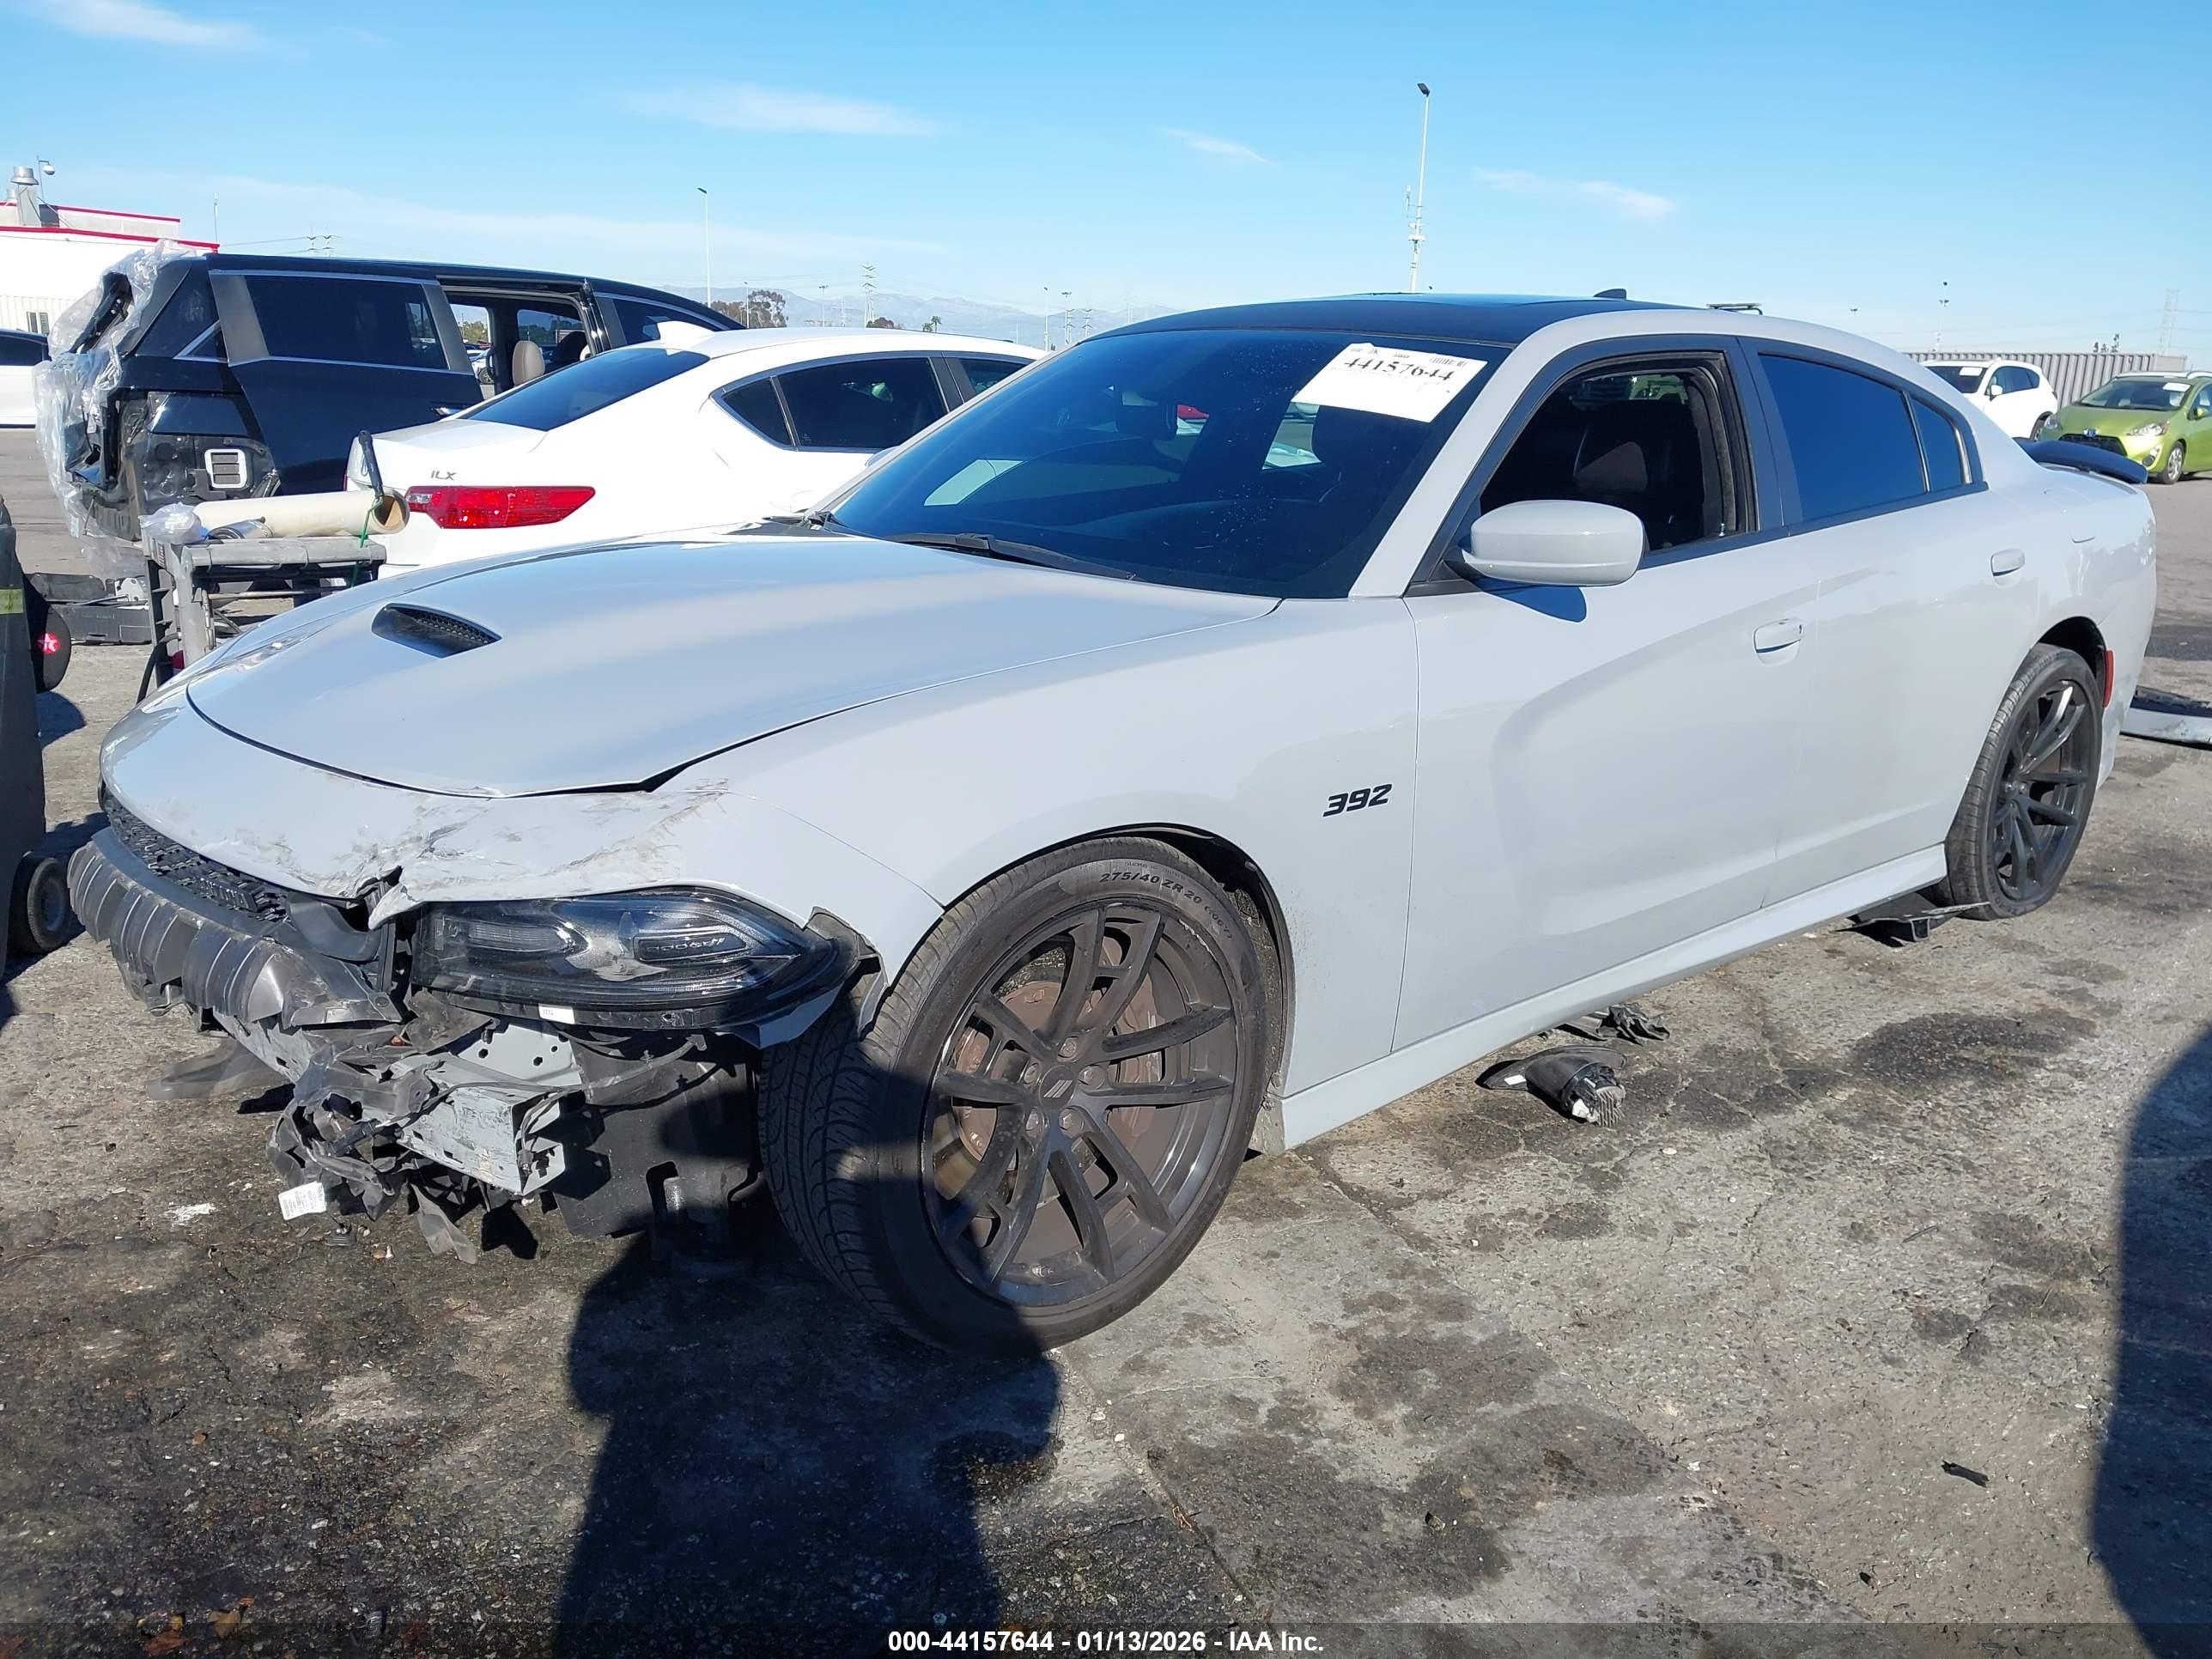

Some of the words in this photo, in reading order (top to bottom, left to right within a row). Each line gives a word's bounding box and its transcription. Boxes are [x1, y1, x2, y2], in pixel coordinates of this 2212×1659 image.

[1344, 358, 1455, 380] 44157644
[431, 471, 456, 480] ILX
[1323, 783, 1393, 817] 392
[1100, 872, 1159, 884] 275/40
[1162, 879, 1183, 893] ZR
[1185, 890, 1202, 903] 20
